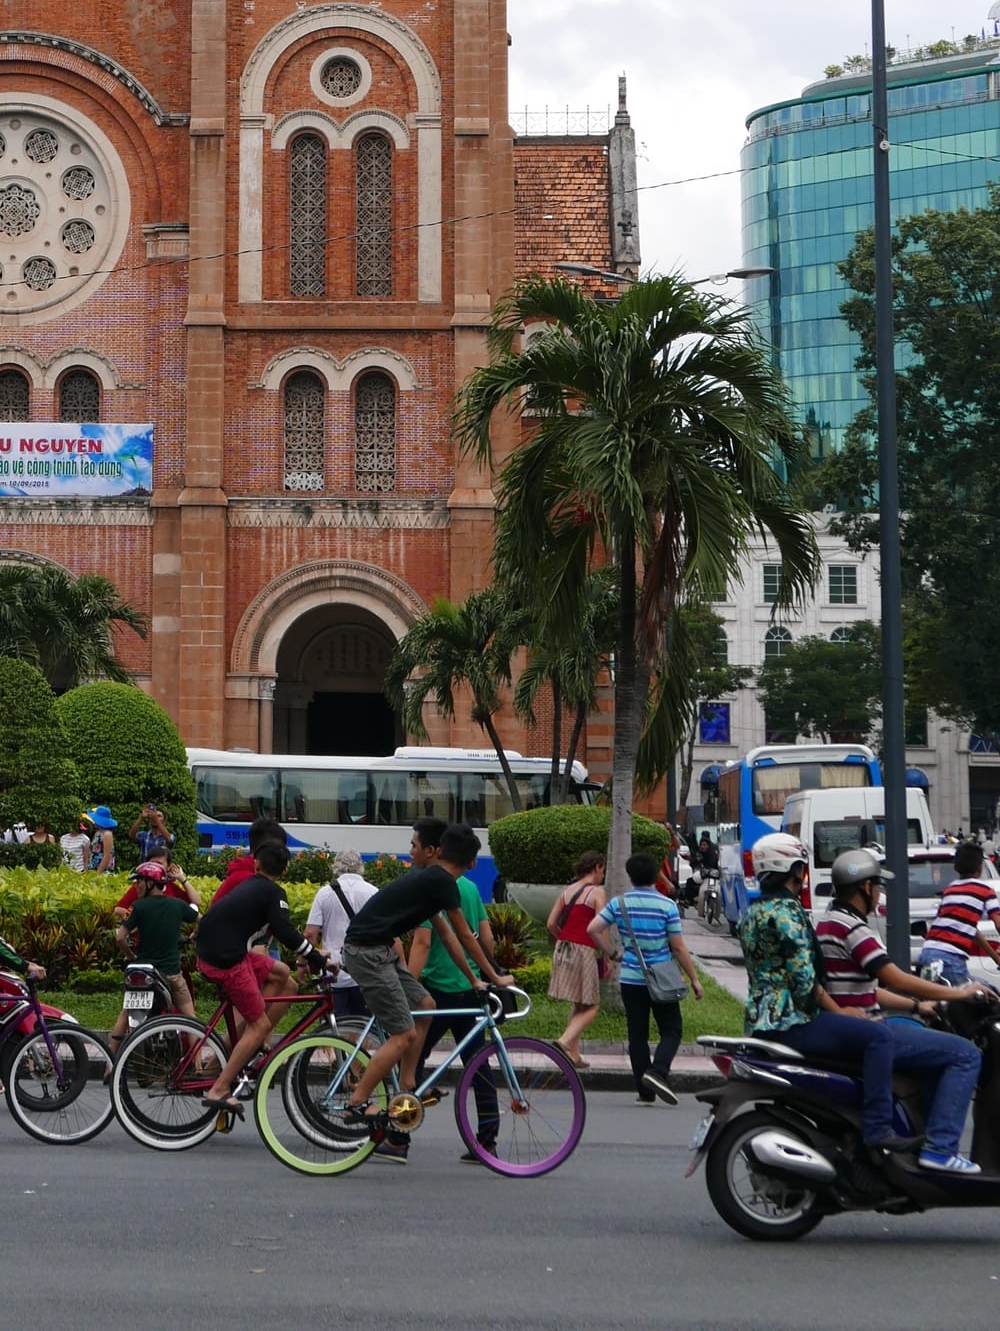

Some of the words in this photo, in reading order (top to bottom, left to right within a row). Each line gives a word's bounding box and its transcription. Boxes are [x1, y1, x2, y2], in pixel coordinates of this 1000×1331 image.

[19, 436, 103, 458] NGUYỆN
[12, 456, 25, 478] vệ
[27, 457, 51, 477] công
[53, 458, 78, 476] trình
[80, 458, 95, 480] tạo
